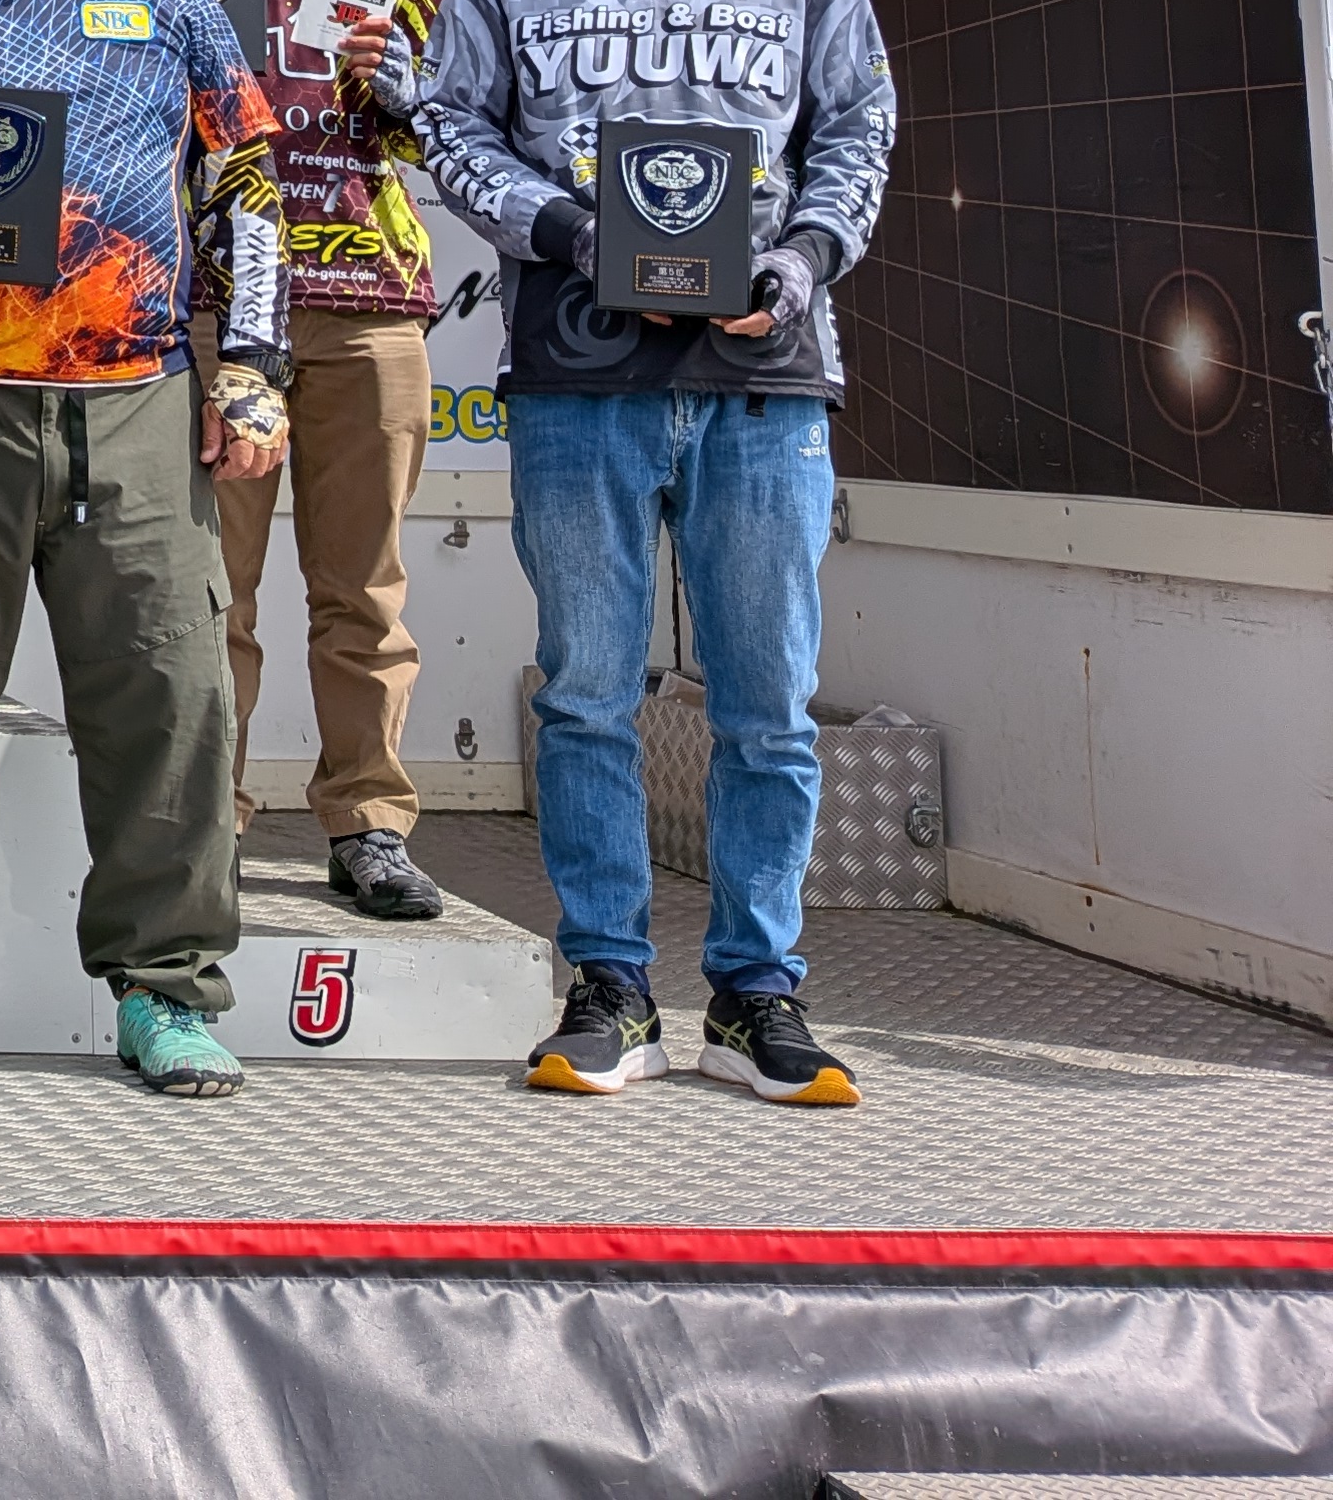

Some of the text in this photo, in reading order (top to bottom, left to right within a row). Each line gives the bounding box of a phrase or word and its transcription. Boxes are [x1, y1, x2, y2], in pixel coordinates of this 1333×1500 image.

[91, 8, 144, 30] NBC
[521, 2, 791, 40] Fishing & Boat
[526, 34, 787, 97] YUUWA
[289, 151, 345, 169] Freegel
[655, 164, 695, 179] NBC
[289, 948, 359, 1047] 5
